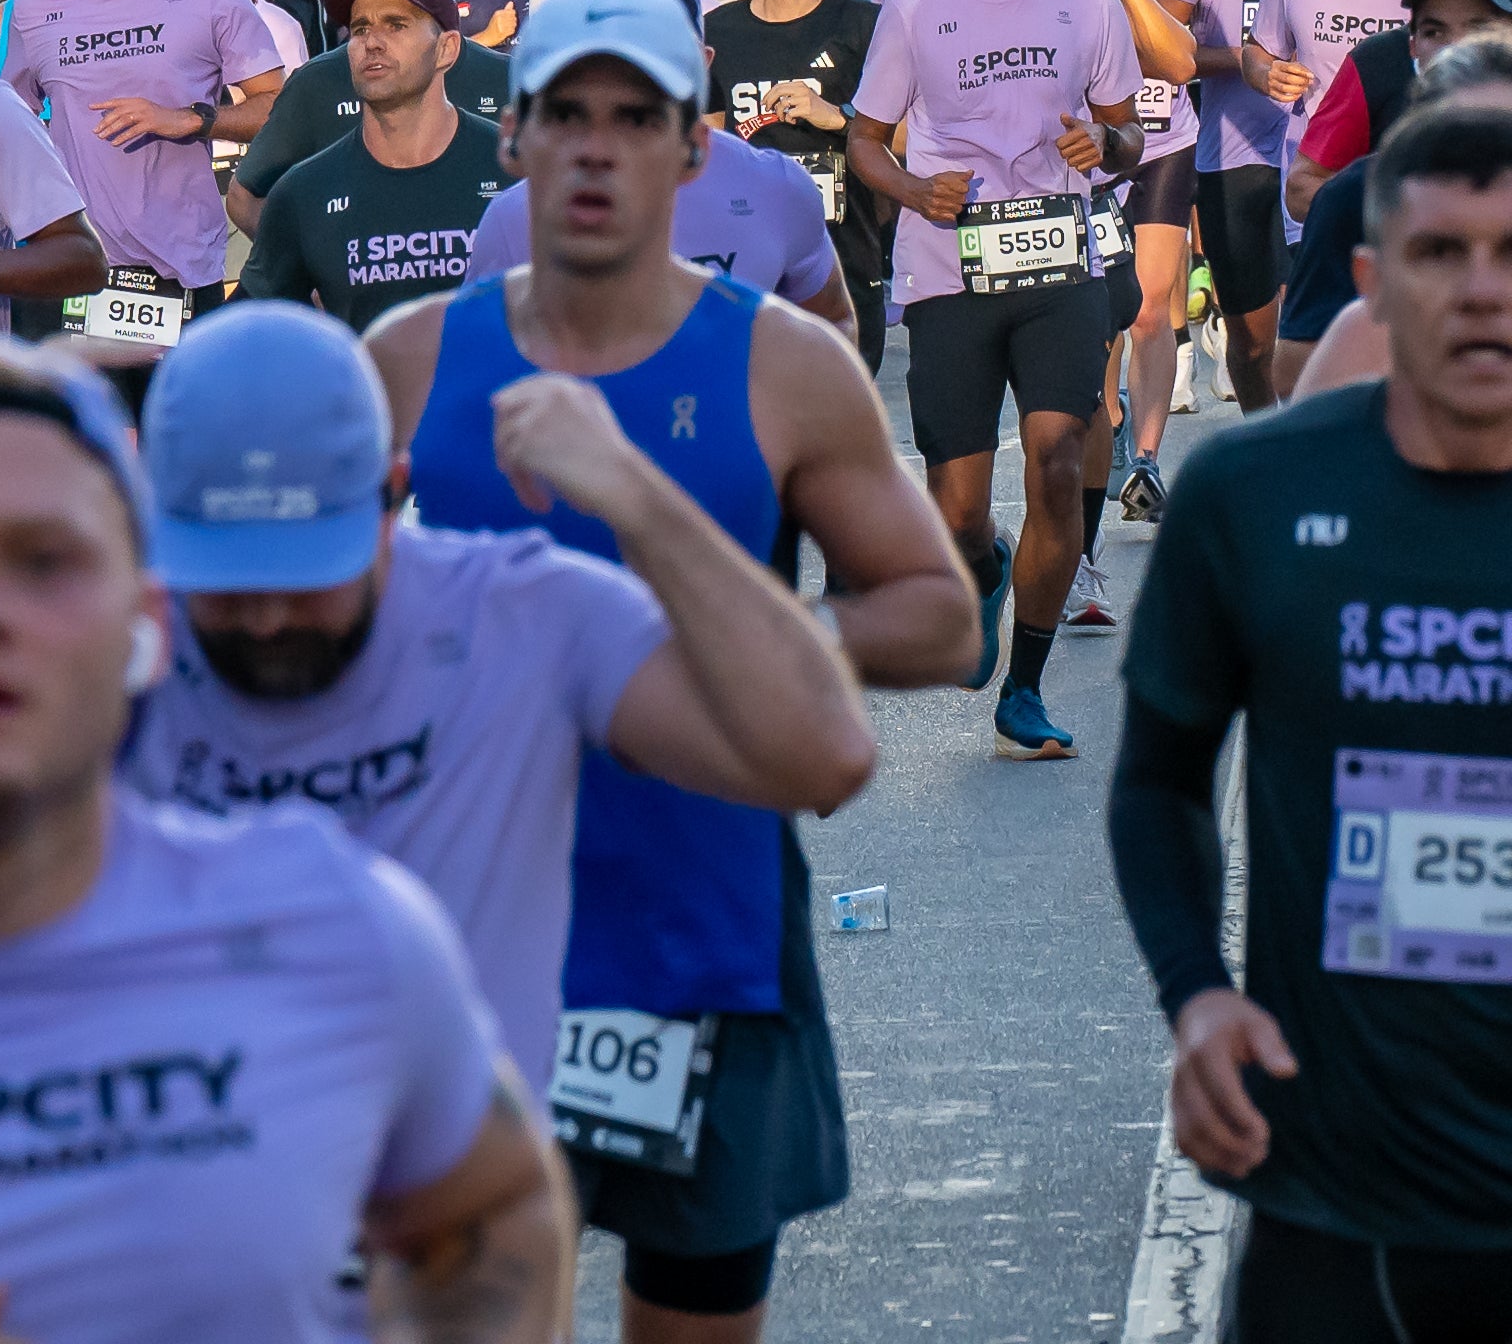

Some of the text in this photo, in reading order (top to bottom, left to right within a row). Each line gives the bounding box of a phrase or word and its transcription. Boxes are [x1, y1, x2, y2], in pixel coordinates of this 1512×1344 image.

[75, 23, 165, 52] SPCITY
[938, 21, 958, 35] nu
[58, 43, 165, 67] HALF MARATHON
[973, 47, 1058, 74] SPCITY
[959, 68, 1059, 91] HALF MARATHON
[337, 100, 361, 116] nu
[327, 195, 350, 214] nu
[1004, 198, 1043, 213] SPCITY
[367, 229, 478, 262] SPCITY
[964, 233, 978, 252] C
[998, 227, 1066, 255] 5550
[348, 257, 472, 287] MARATHO
[1015, 256, 1054, 269] CLEYTON
[118, 269, 158, 286] SPCITY
[108, 299, 166, 328] 9161
[114, 328, 156, 341] MAURICIO
[1348, 824, 1374, 866] D
